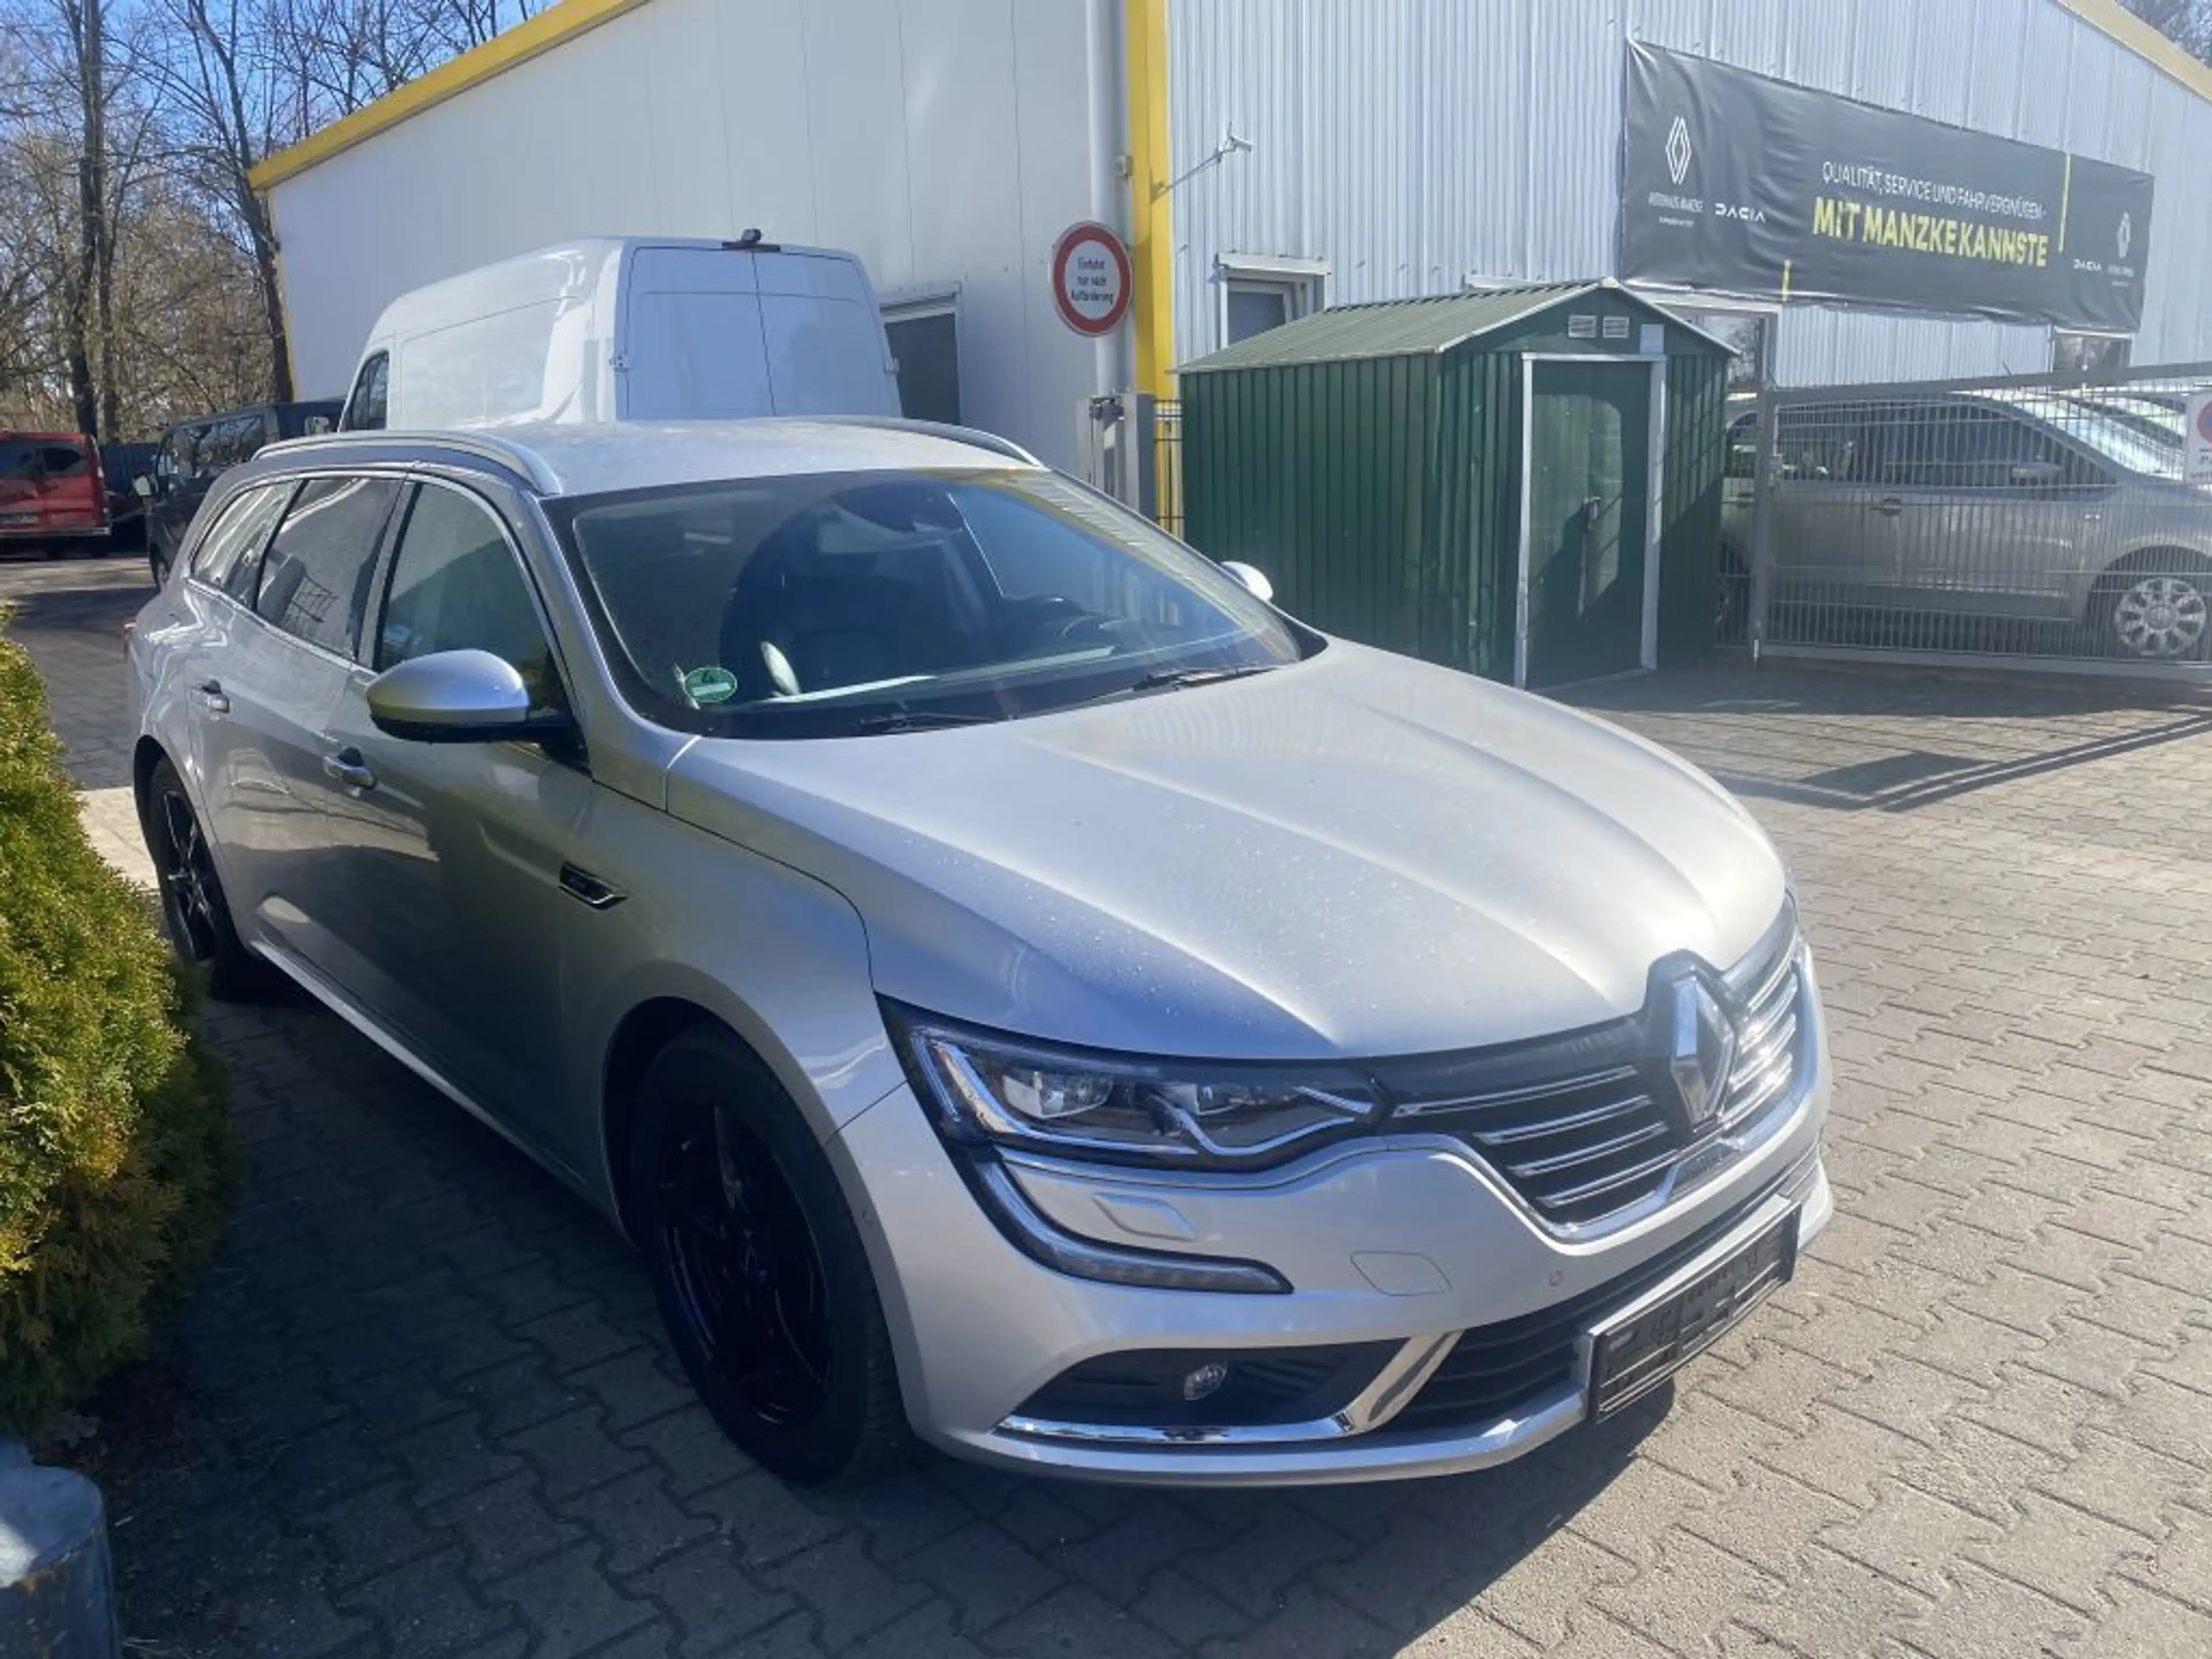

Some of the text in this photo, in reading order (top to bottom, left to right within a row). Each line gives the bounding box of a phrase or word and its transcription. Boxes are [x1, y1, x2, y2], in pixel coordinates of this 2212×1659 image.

[1884, 173, 1931, 202] SERVICE
[1933, 183, 1956, 204] UND
[1714, 202, 1766, 224] DACIA
[1813, 196, 2049, 267] MIT MANZKE KANNSTE
